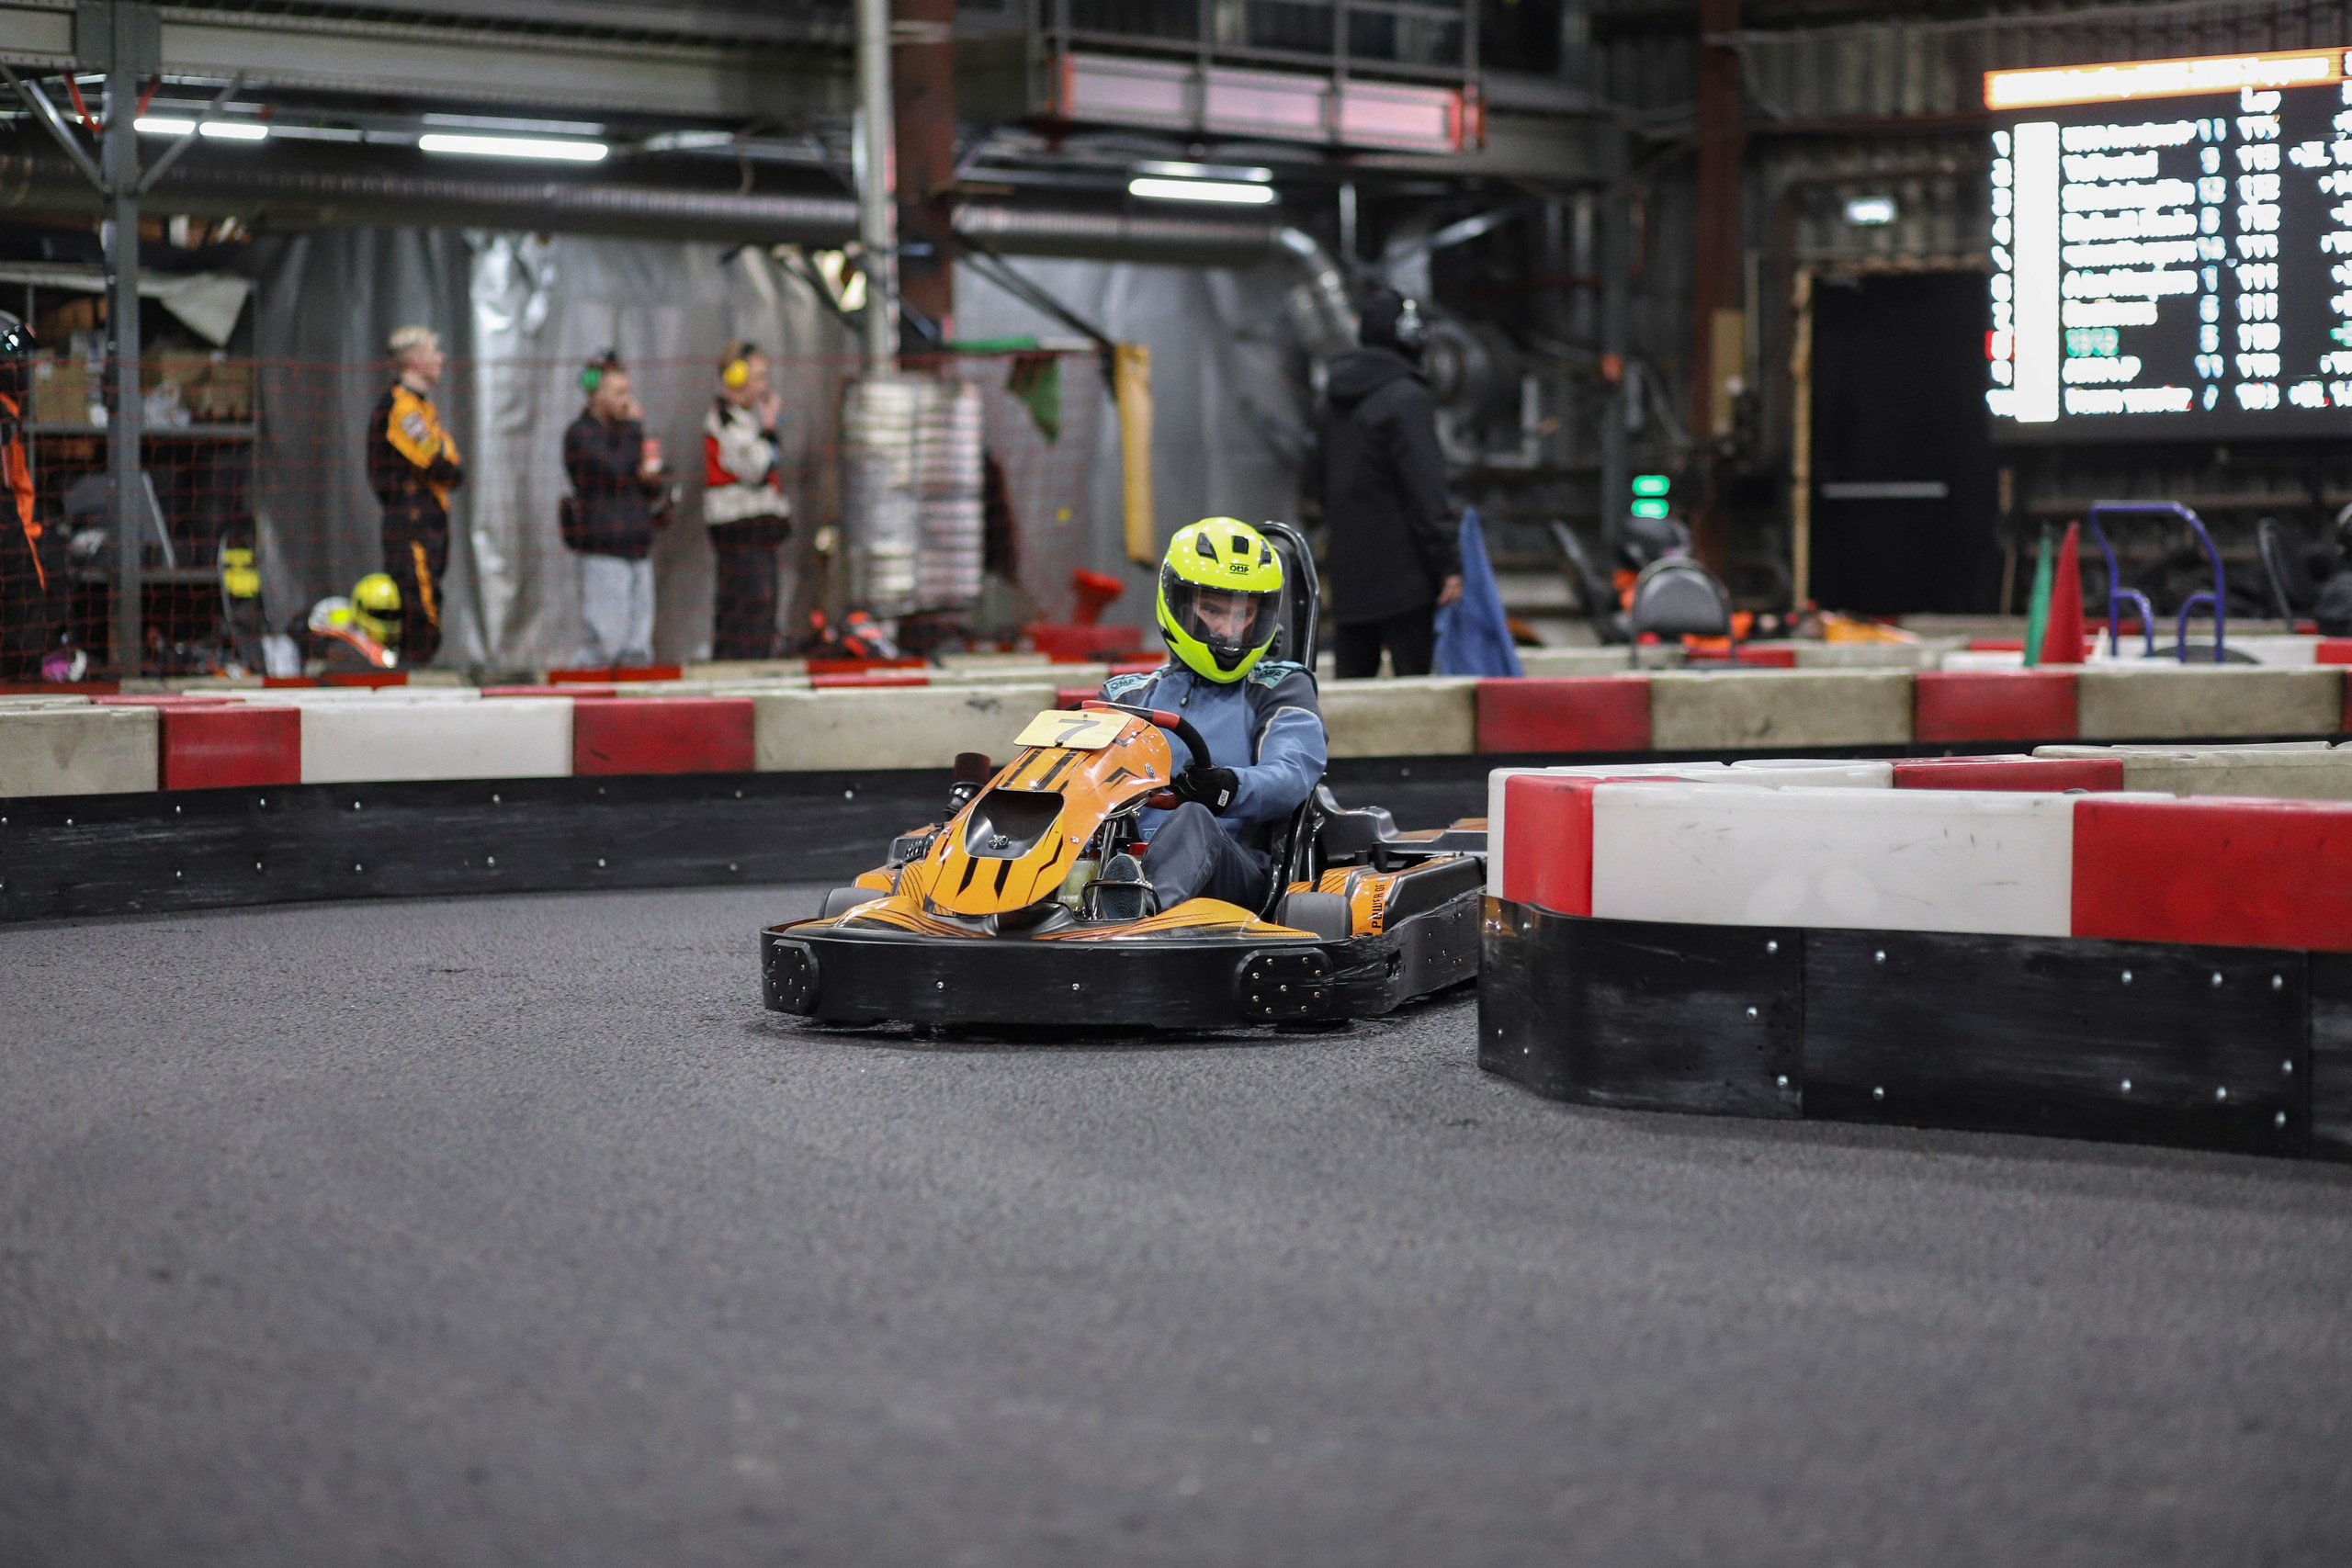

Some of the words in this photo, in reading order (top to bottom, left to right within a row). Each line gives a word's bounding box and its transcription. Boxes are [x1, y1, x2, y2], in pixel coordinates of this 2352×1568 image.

[1229, 565, 1250, 573] OMP
[1110, 679, 1136, 690] OMP
[1055, 719, 1101, 741] 7
[1372, 893, 1384, 929] POWER
